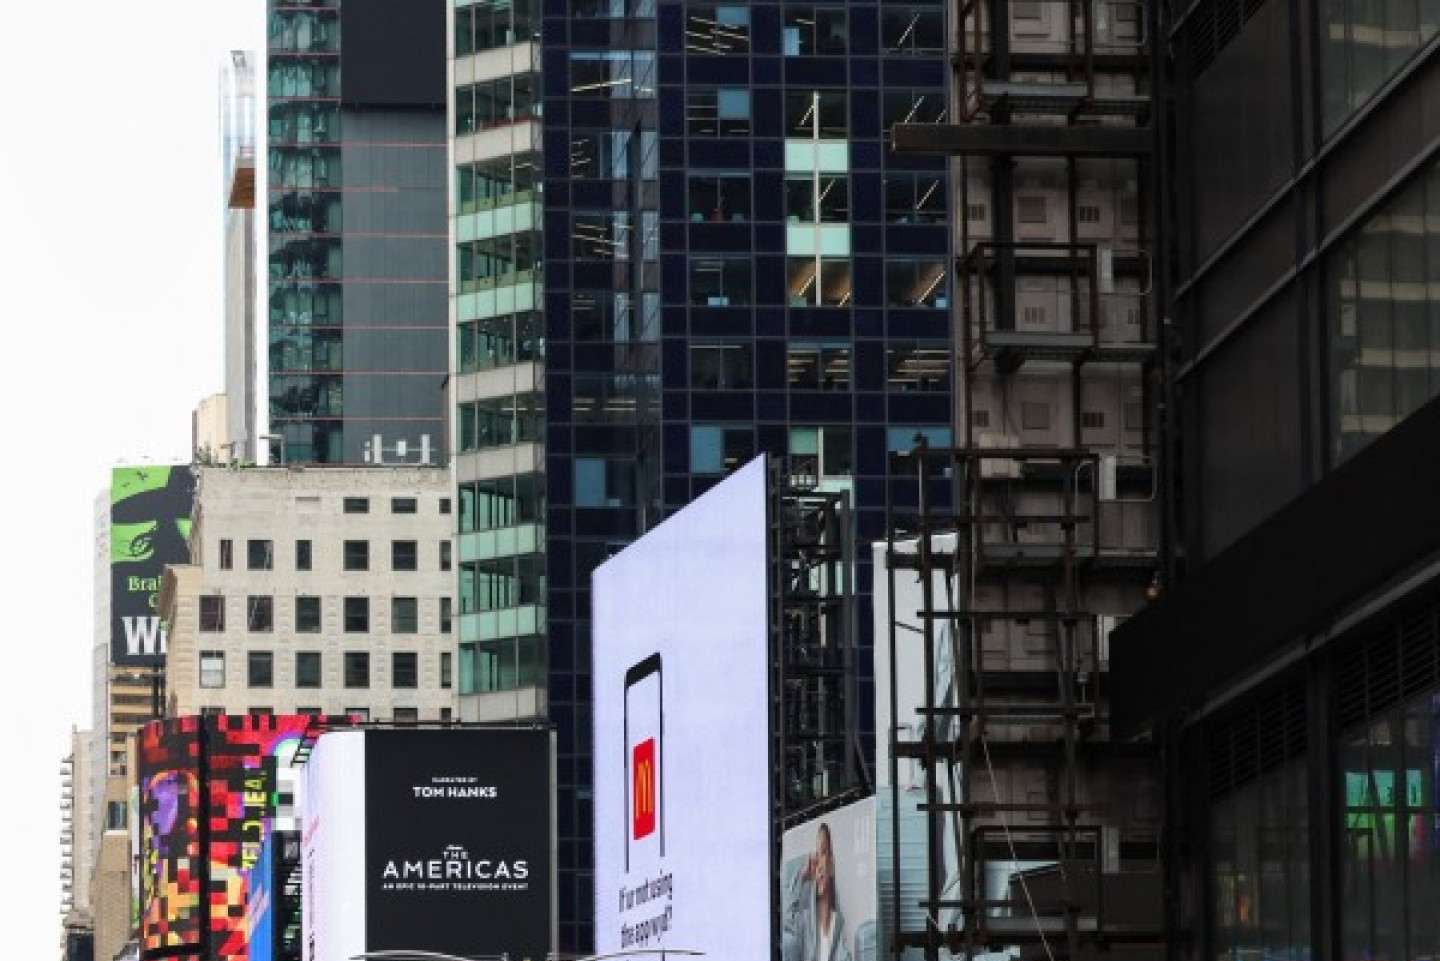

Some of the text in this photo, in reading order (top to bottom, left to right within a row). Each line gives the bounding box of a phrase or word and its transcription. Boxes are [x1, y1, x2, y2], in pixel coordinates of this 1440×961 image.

[413, 786, 498, 798] TOM HANKS
[442, 851, 469, 860] THE
[382, 860, 530, 879] AMERICAS
